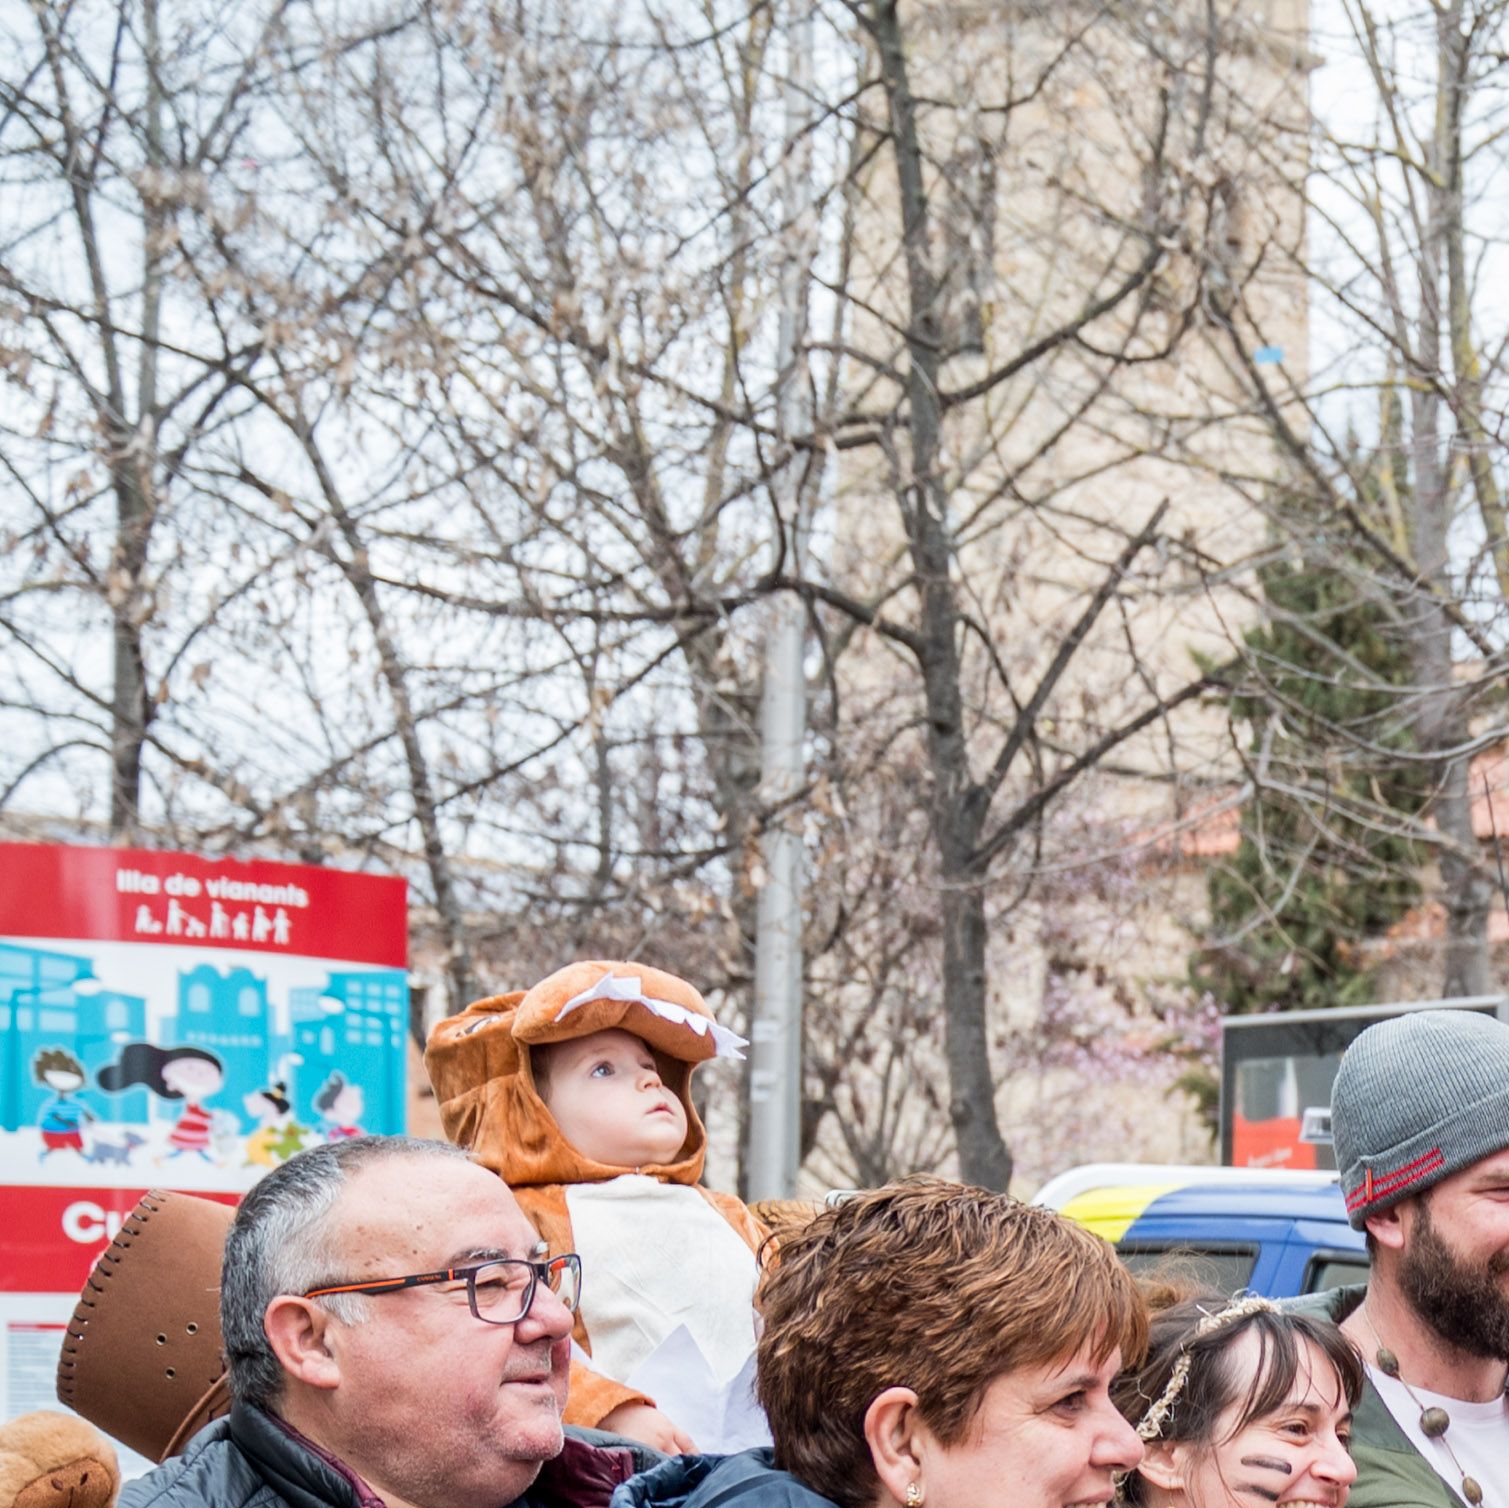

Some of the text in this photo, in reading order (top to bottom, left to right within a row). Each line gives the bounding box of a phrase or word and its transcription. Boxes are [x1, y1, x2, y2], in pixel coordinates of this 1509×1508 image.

[116, 868, 309, 908] Illa de vianants
